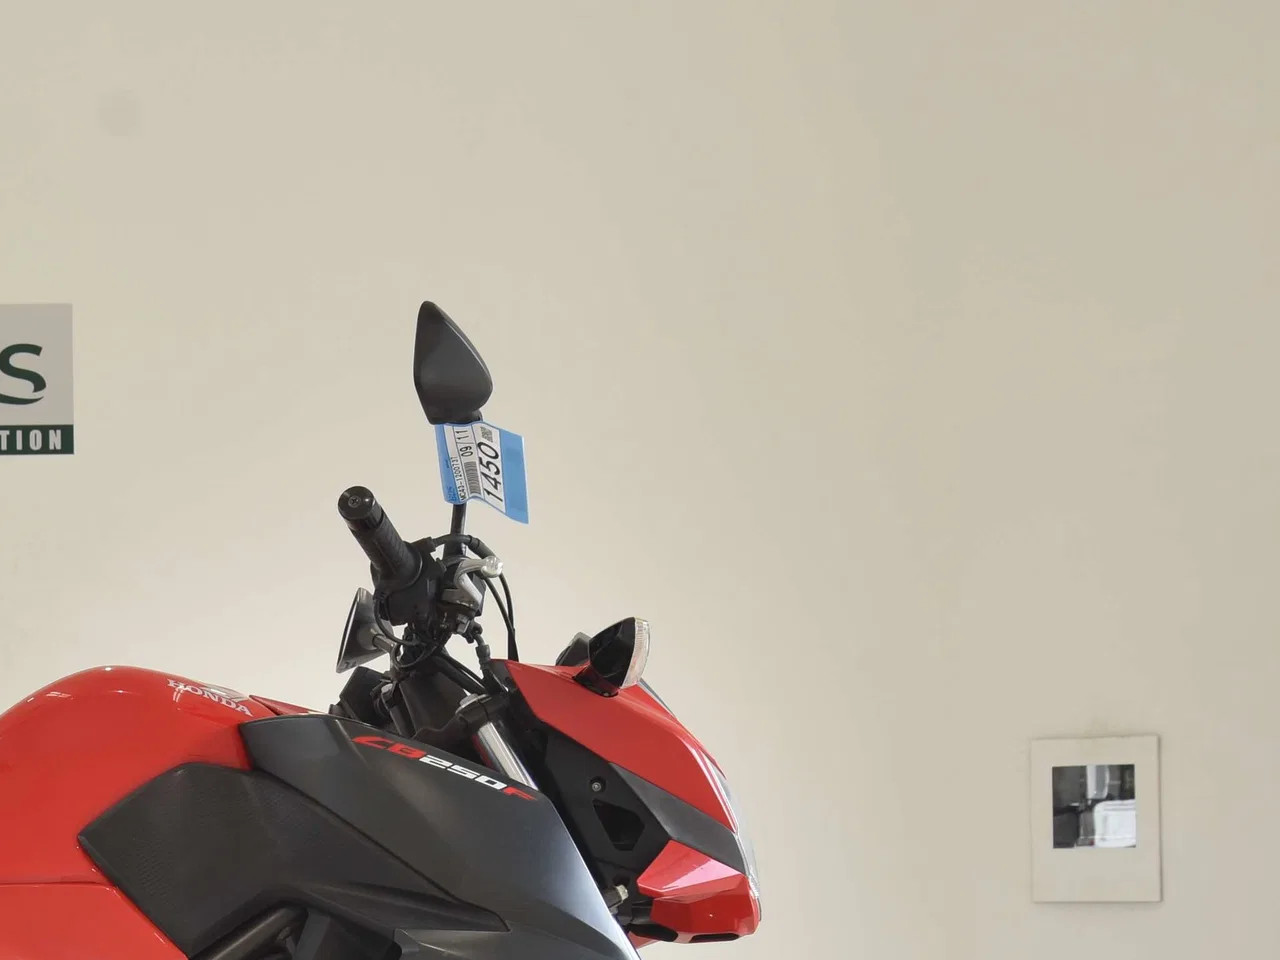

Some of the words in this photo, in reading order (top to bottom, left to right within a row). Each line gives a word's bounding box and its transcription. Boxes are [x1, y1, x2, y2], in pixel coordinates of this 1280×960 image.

[477, 441, 504, 503] 1450
[167, 678, 253, 717] HONDA
[351, 735, 538, 801] CB250F
